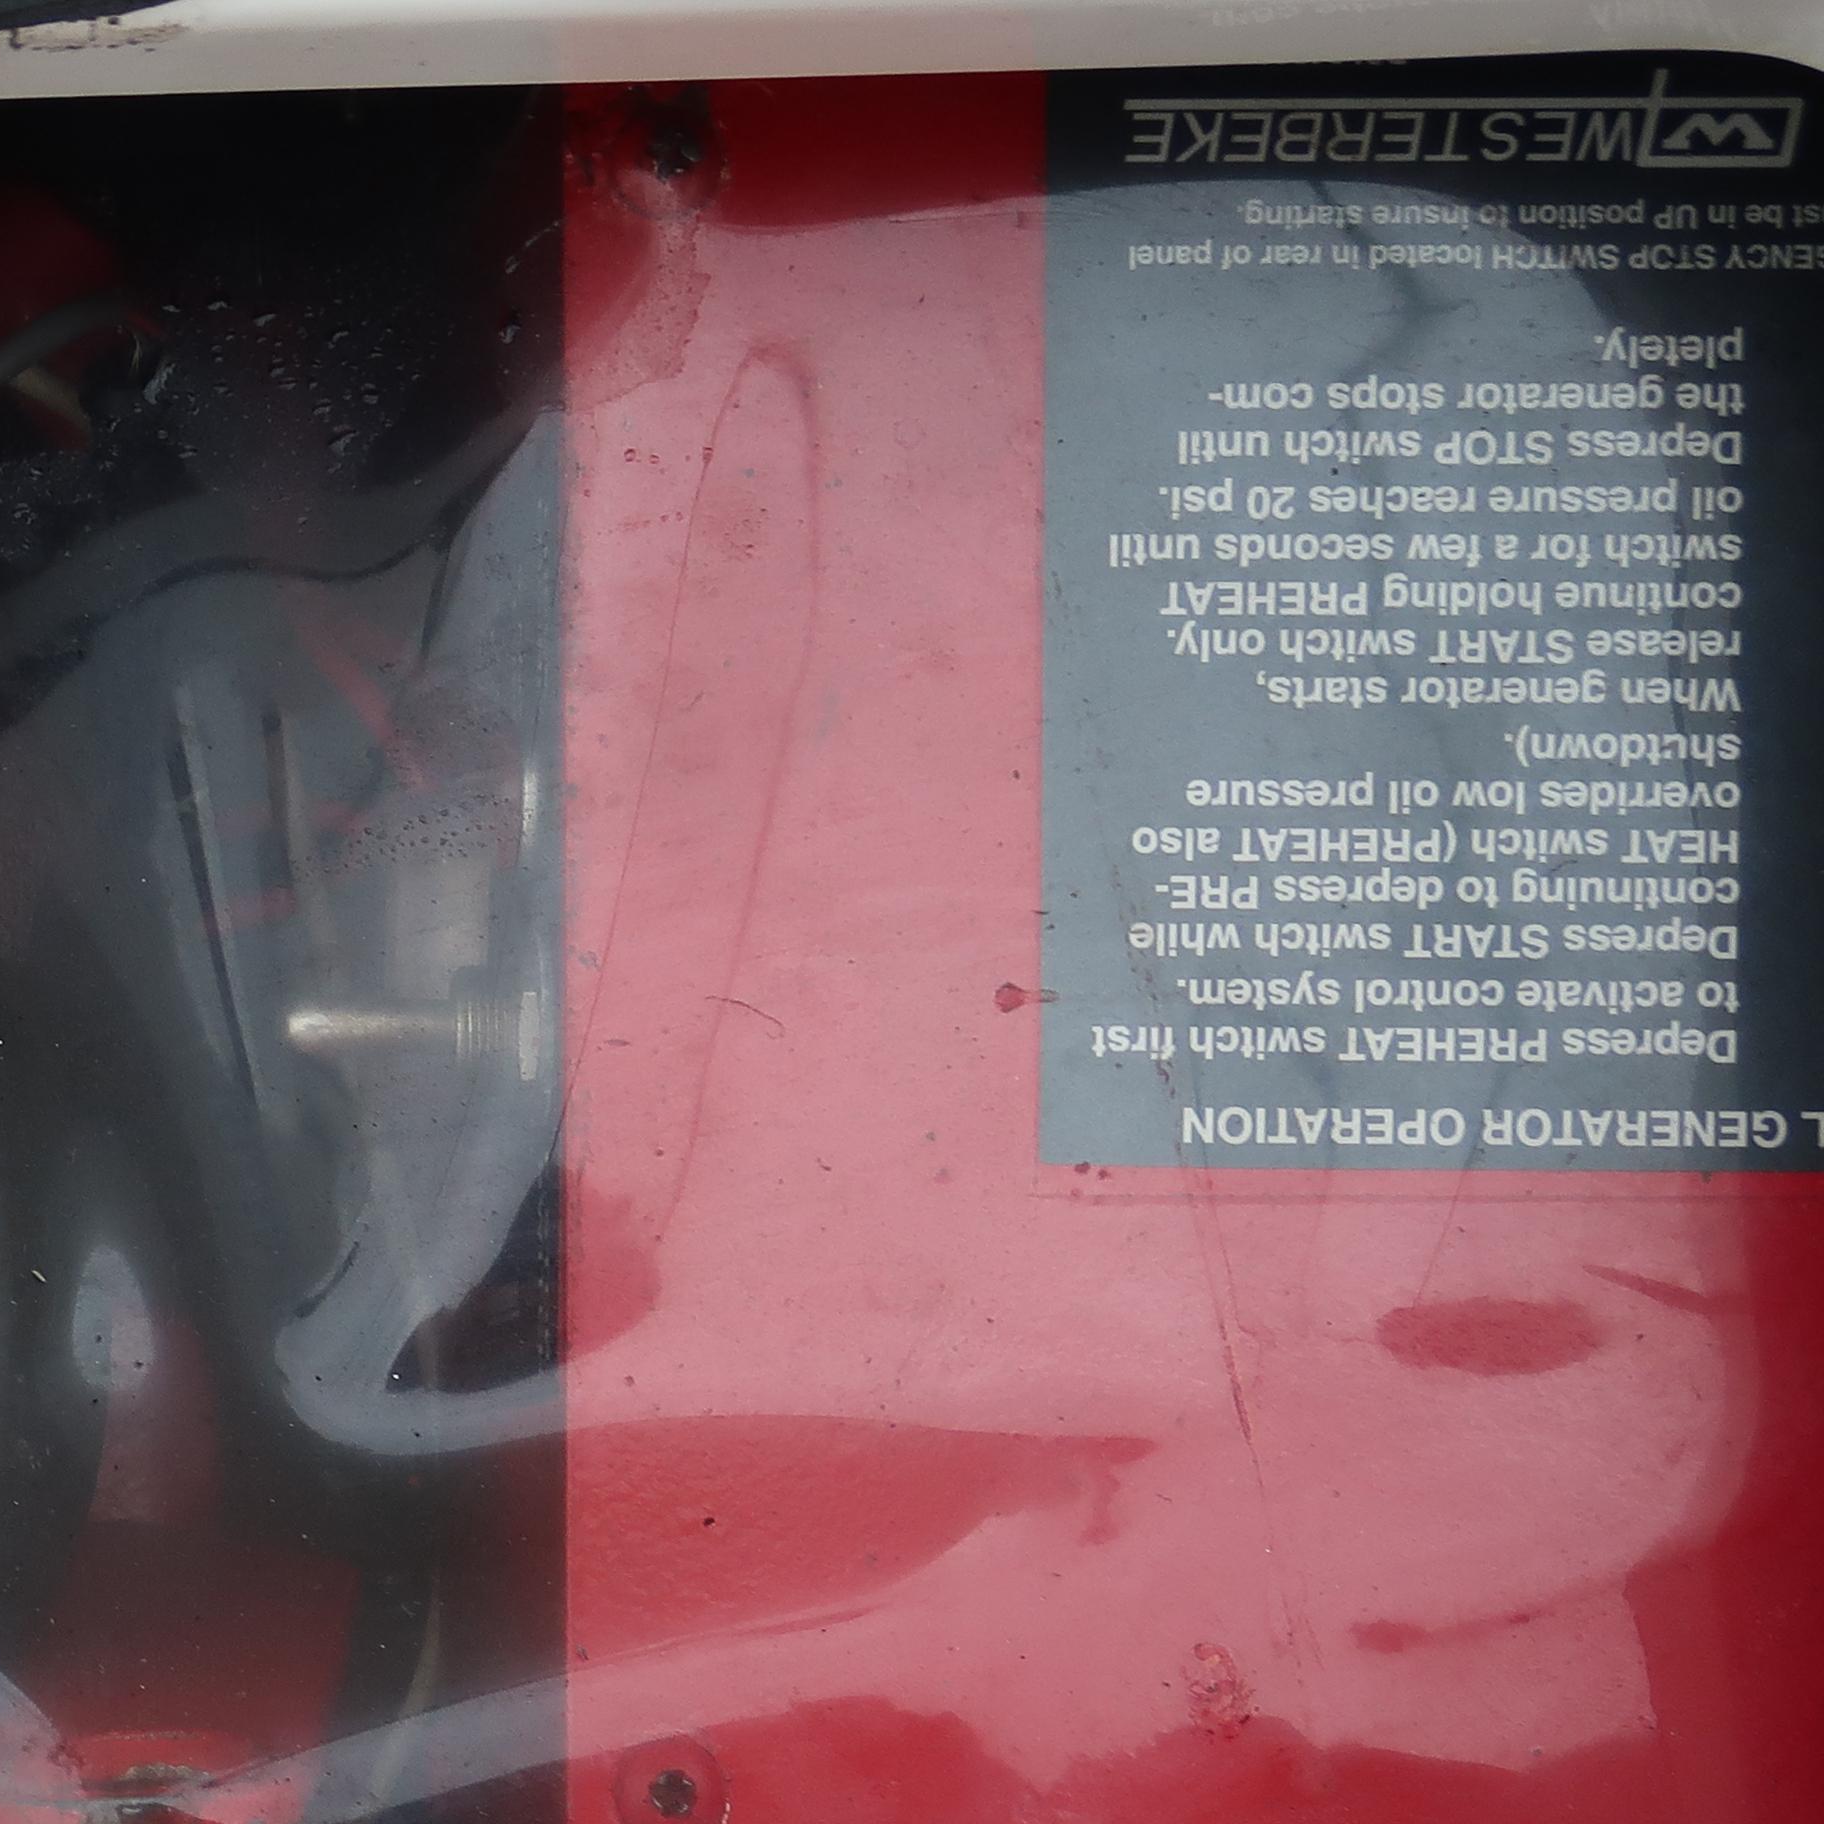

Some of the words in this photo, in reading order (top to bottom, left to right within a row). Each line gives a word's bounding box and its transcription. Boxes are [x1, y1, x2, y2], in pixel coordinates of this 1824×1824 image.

[1125, 111, 1631, 162] WESTERBEKE
[1237, 199, 1364, 230] starting.
[1372, 205, 1470, 230] insure
[1475, 205, 1508, 228] to
[1519, 199, 1645, 229] position
[1653, 205, 1697, 229] UP
[1708, 205, 1736, 229] in
[1745, 205, 1782, 229] be
[1129, 239, 1212, 270] panel
[1221, 245, 1252, 270] of
[1260, 245, 1322, 264] rear
[1332, 245, 1359, 269] in
[1368, 245, 1482, 269] located
[1493, 244, 1620, 270] SWITCH
[1628, 244, 1716, 270] STOP
[1595, 327, 1743, 369] pletely.
[1208, 383, 1314, 409] com-
[1327, 374, 1445, 415] stops
[1457, 374, 1664, 414] generator
[1676, 383, 1744, 416] the
[1179, 431, 1269, 464] until
[1285, 430, 1421, 464] switch
[1434, 430, 1554, 465] STOP
[1568, 422, 1742, 464] Depress
[1159, 478, 1232, 520] psi.
[1247, 486, 1295, 519] 20
[1309, 486, 1475, 519] reaches
[1488, 478, 1677, 512] pressure
[1693, 487, 1743, 520] oil
[1110, 534, 1199, 567] until
[1215, 533, 1394, 567] seconds
[1408, 534, 1482, 567] few
[1495, 535, 1518, 560] a
[1531, 534, 1591, 568] for
[1605, 534, 1742, 568] switch
[1160, 582, 1367, 615] PREHEAT
[1384, 573, 1542, 615] holding
[1555, 582, 1741, 616] continue
[1167, 620, 1265, 662] only.
[1280, 629, 1416, 663] switch
[1428, 629, 1574, 664] START
[1587, 630, 1741, 663] release
[1256, 671, 1388, 708] starts,
[1401, 669, 1606, 708] generator
[1622, 678, 1741, 712] When
[1504, 725, 1742, 767] shutdown).
[1186, 772, 1373, 806] pressure
[1389, 780, 1439, 814] oil
[1452, 781, 1525, 814] low
[1540, 781, 1740, 815] overrides
[1132, 827, 1220, 861] also
[1233, 820, 1456, 863] (PREHEAT
[1471, 828, 1608, 863] switch
[1621, 830, 1738, 864] HEAT
[1155, 876, 1258, 909] PRE-
[1274, 867, 1443, 910] depress
[1456, 877, 1498, 908] to
[1513, 868, 1739, 911] continuing
[1128, 922, 1240, 956] while
[1255, 923, 1391, 957] switch
[1404, 924, 1549, 959] START
[1563, 917, 1737, 959] Depress
[1177, 971, 1340, 1010] system.
[1355, 979, 1504, 1013] control
[1516, 980, 1684, 1014] activate
[1697, 981, 1740, 1013] to
[1092, 1026, 1175, 1060] first
[1190, 1026, 1326, 1060] switch
[1339, 1028, 1547, 1062] PREHEAT
[1563, 1021, 1736, 1063] Depress
[1183, 1107, 1465, 1146] OPERATION
[1483, 1109, 1787, 1148] GENERATOR
